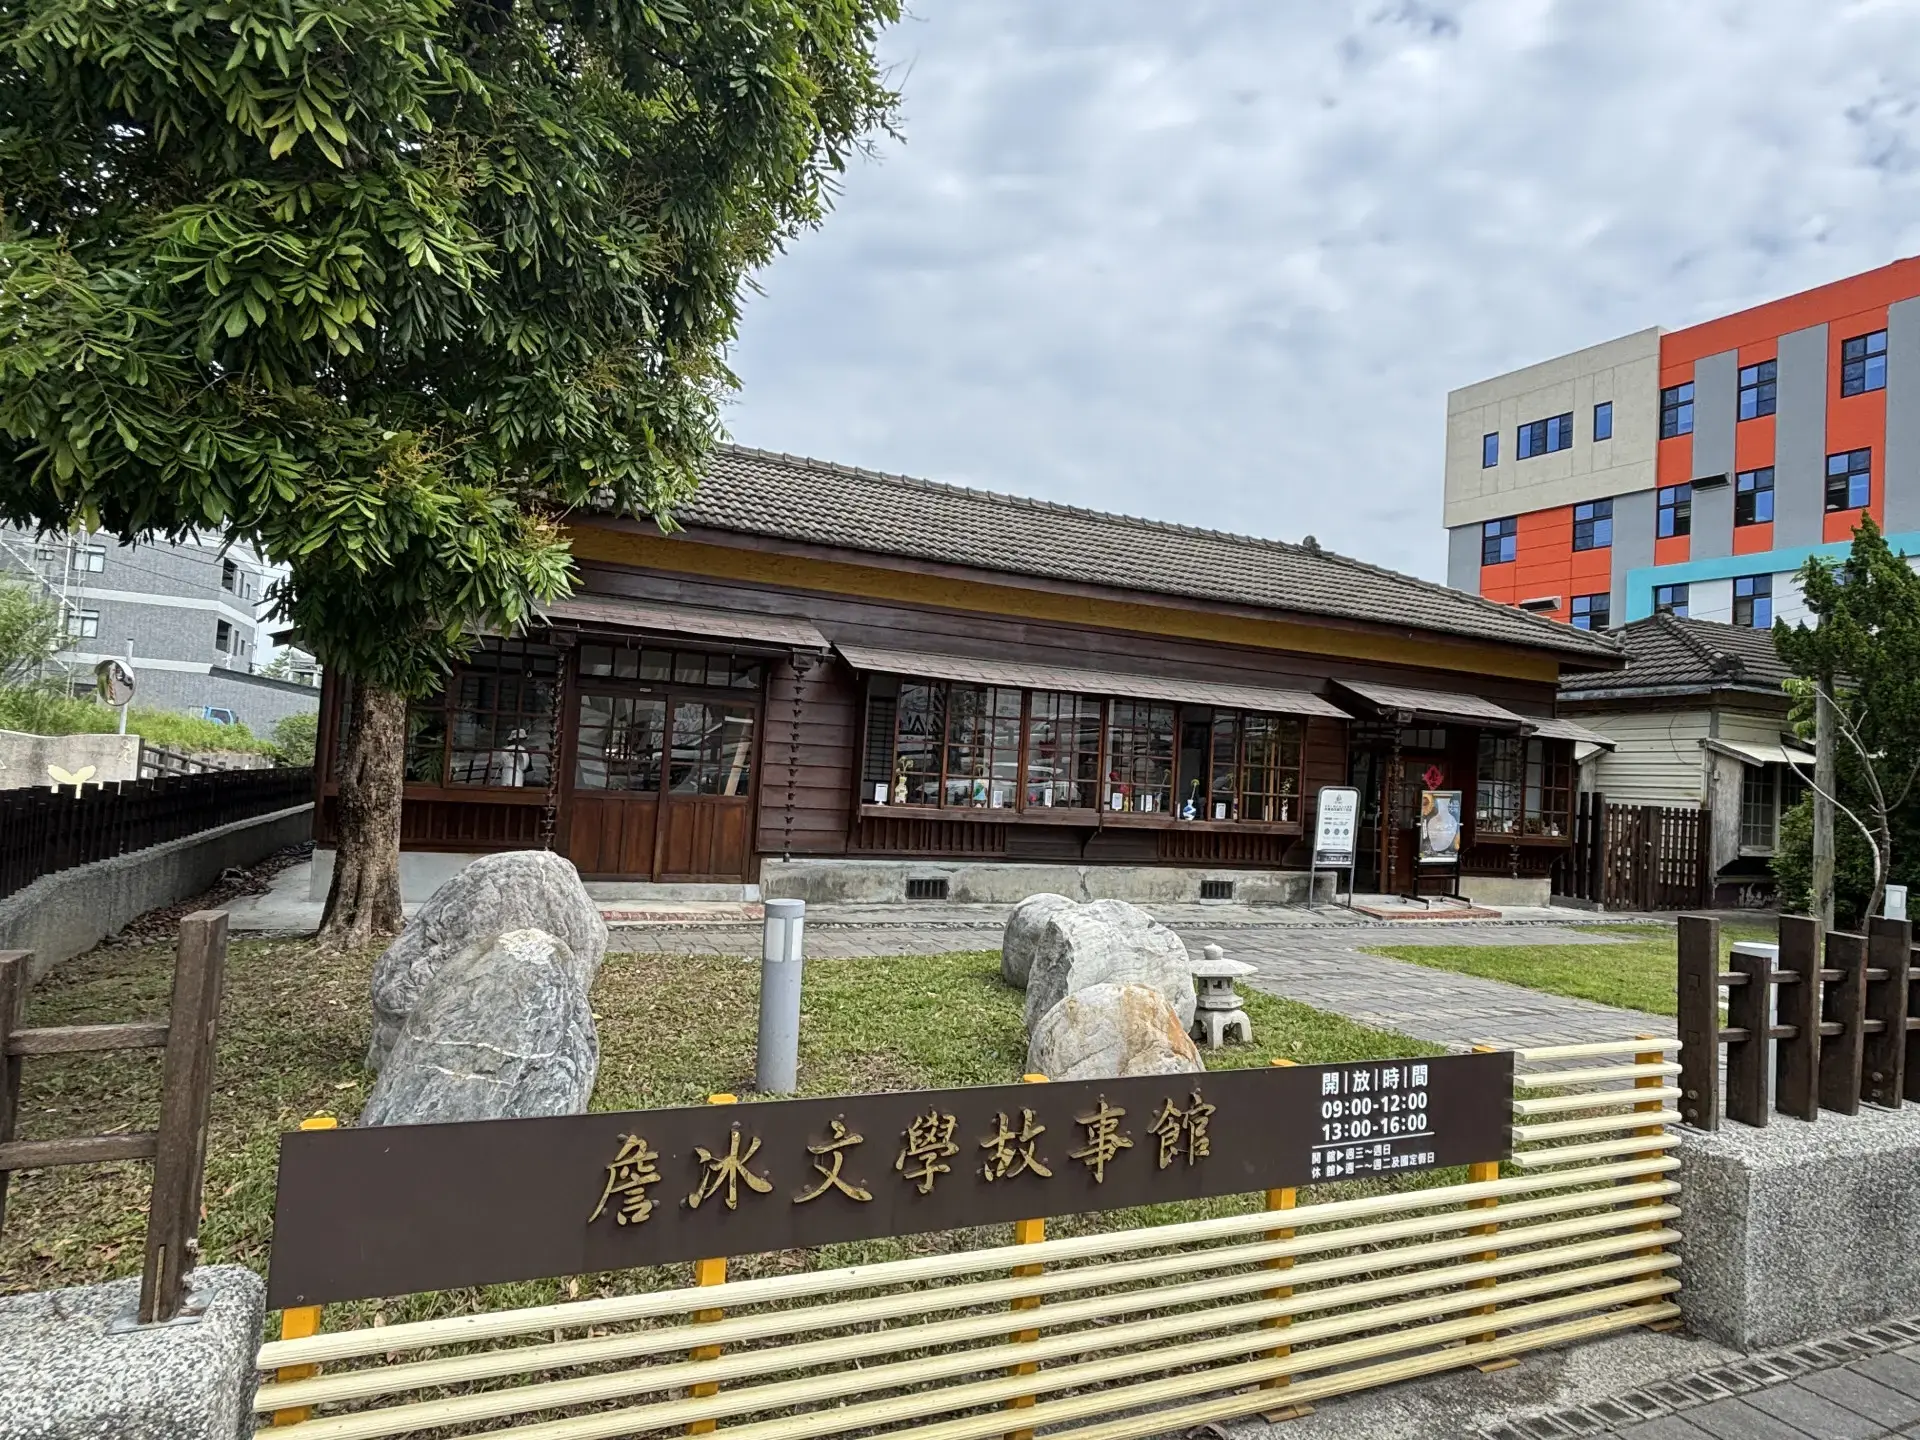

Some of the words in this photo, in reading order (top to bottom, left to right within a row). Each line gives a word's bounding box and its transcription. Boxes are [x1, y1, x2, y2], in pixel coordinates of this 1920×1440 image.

[1322, 1092, 1428, 1119] 09:00-12:00
[1322, 1113, 1428, 1141] 13:00-16:00
[588, 1092, 1216, 1225] 詹冰文學故事館
